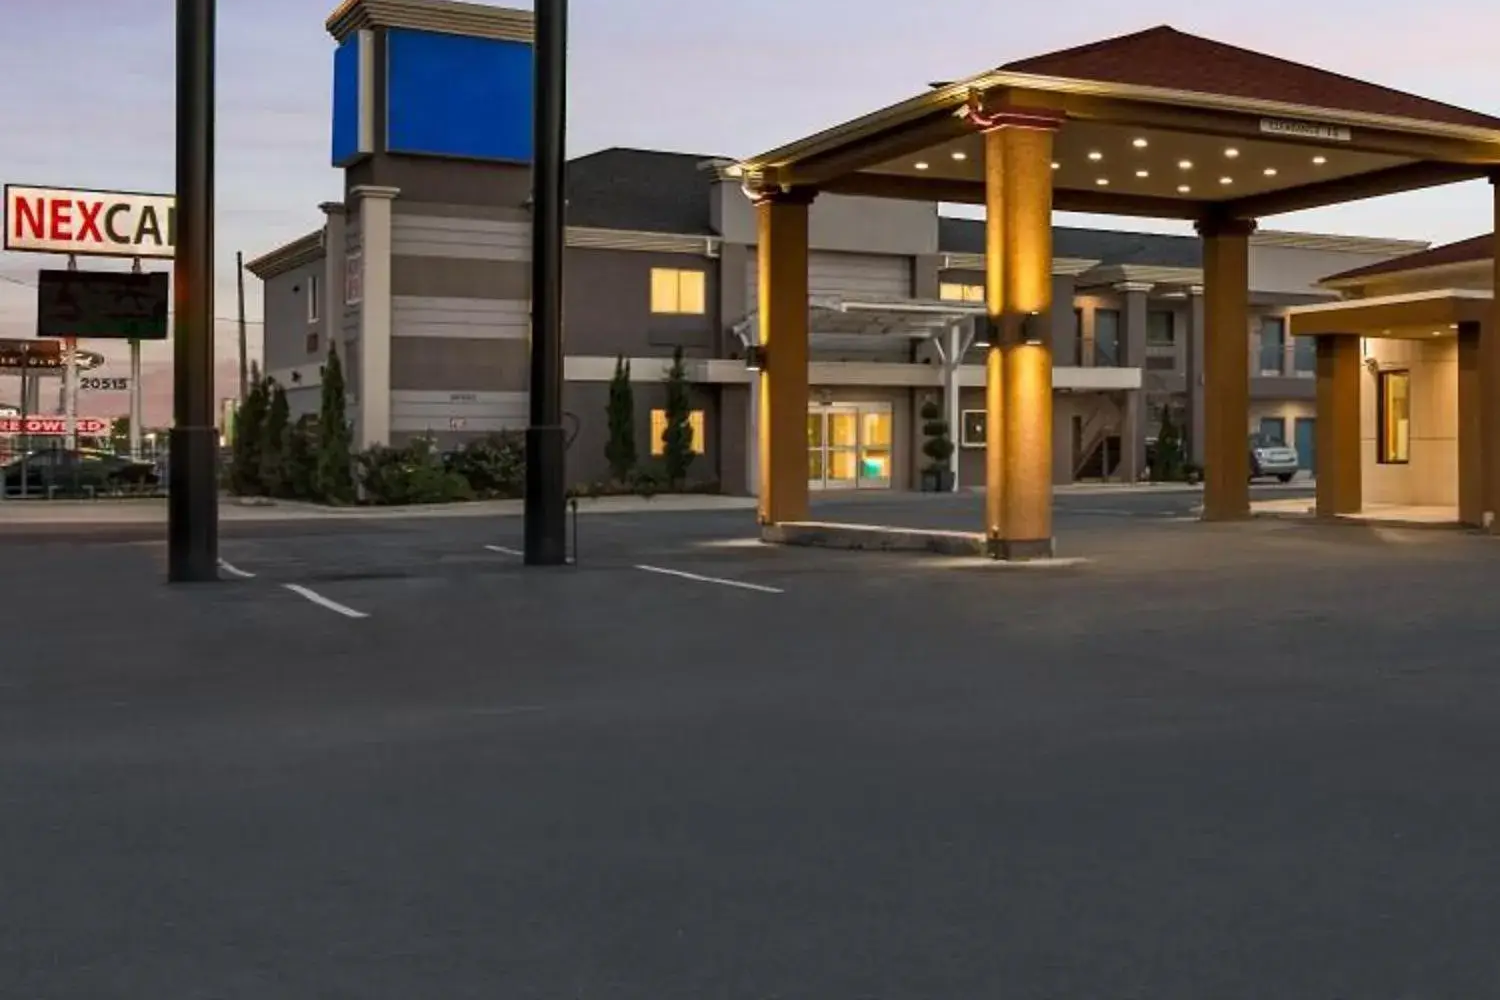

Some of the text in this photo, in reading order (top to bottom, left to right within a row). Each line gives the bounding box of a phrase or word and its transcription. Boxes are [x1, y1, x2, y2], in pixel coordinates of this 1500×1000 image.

[15, 196, 176, 246] NEXCA
[80, 377, 128, 390] 20515
[27, 421, 101, 431] OWED
